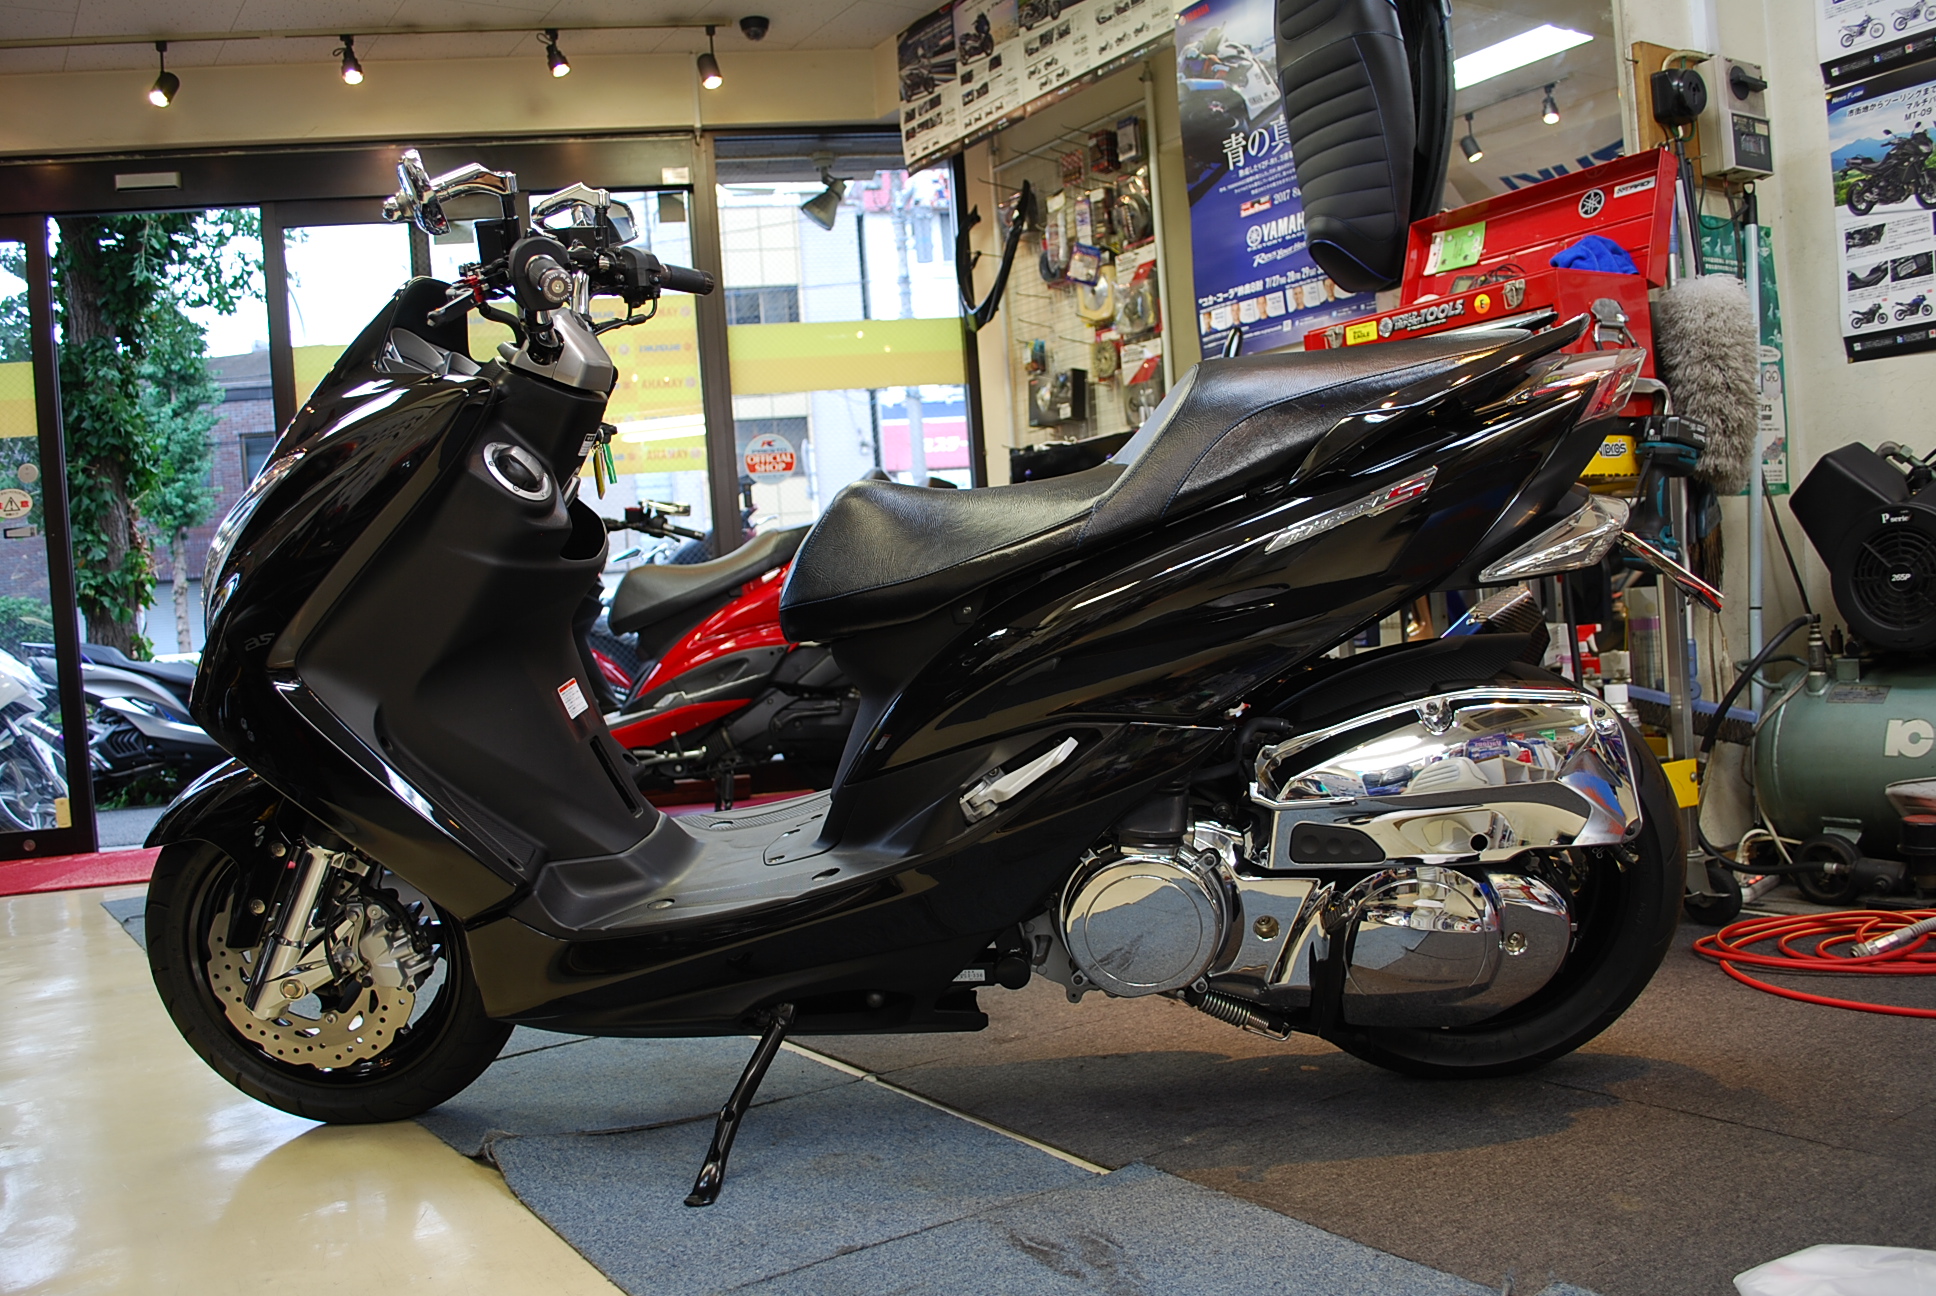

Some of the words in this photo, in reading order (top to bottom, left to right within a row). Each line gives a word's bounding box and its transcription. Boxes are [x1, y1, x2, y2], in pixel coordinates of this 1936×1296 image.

[1185, 4, 1210, 23] YAMAHA
[1273, 190, 1290, 205] 2017
[1247, 237, 1283, 252] FACTORY
[746, 453, 793, 465] OFFICIAL
[755, 461, 786, 472] SHOP
